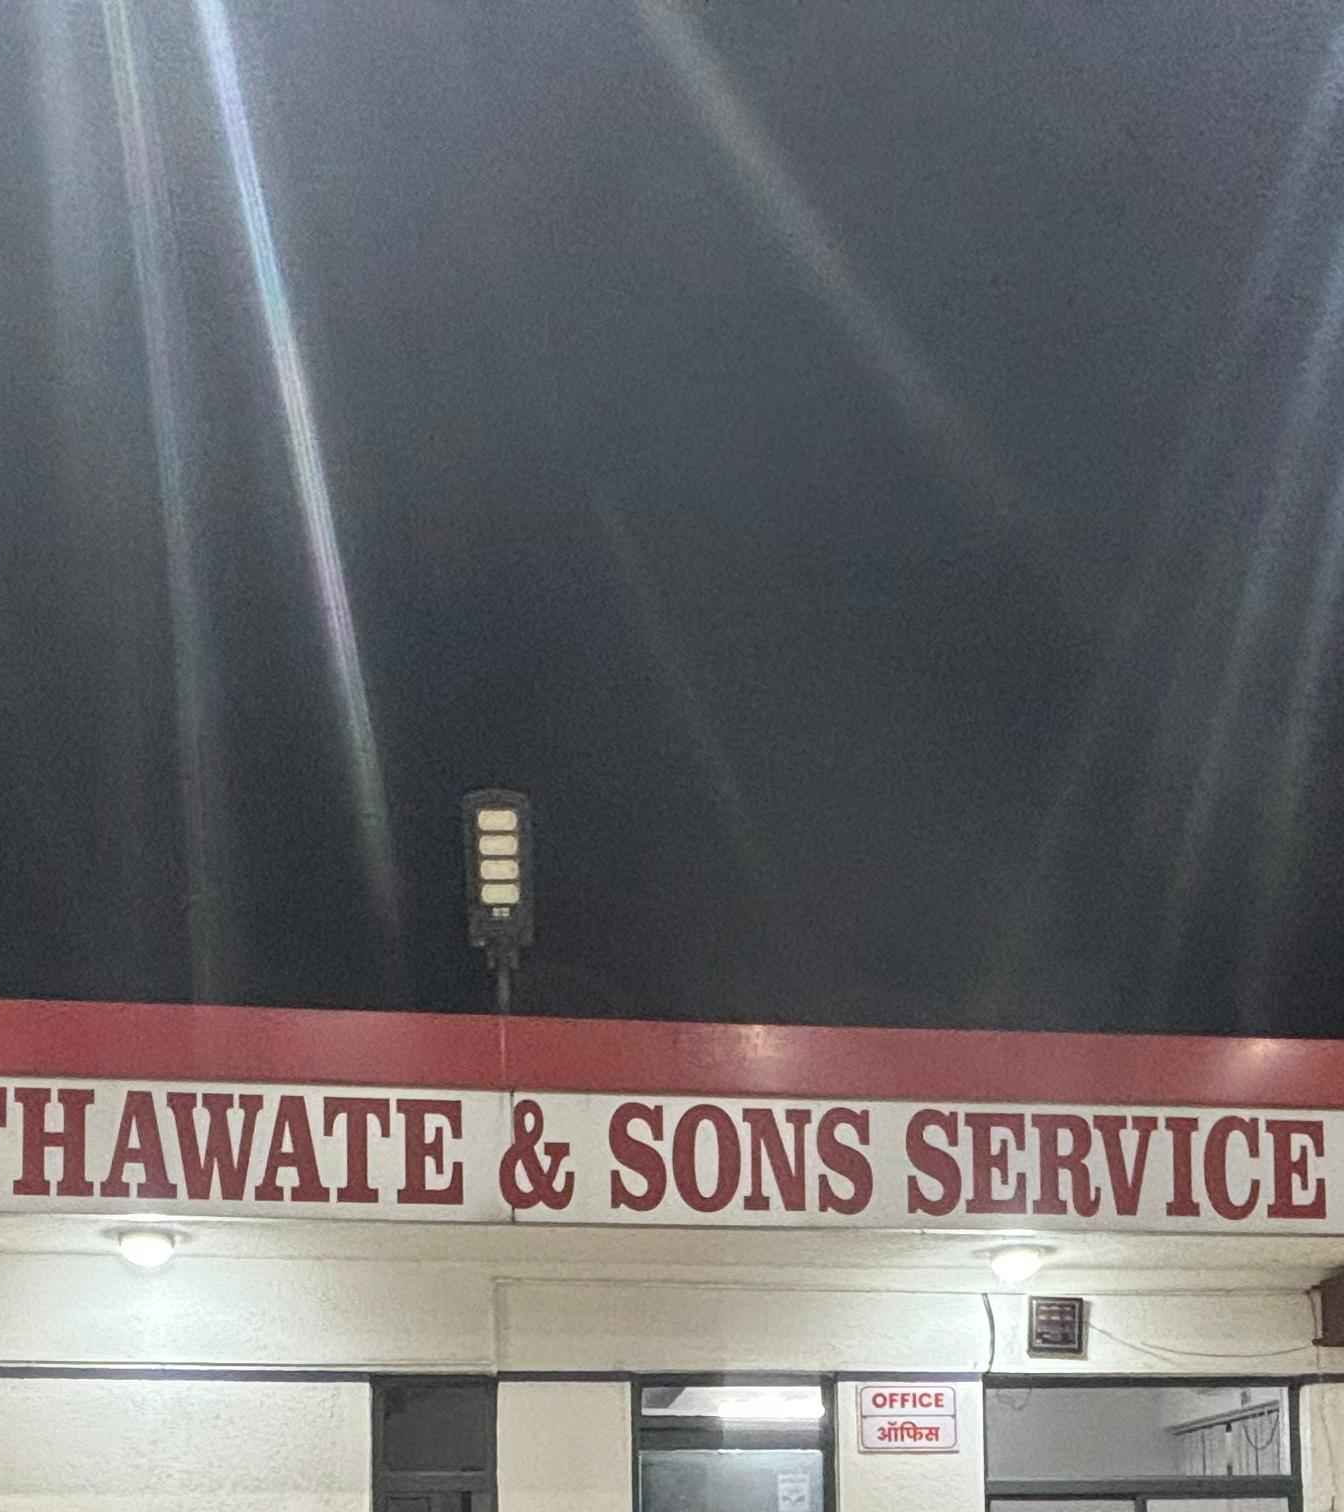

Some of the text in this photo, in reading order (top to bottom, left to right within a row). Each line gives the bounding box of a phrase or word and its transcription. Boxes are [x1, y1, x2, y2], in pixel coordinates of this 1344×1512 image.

[499, 1100, 575, 1210] &
[609, 1102, 873, 1215] SONS
[906, 1108, 1327, 1221] SERVICE
[872, 1393, 944, 1408] OFFICE
[877, 1421, 940, 1442] ऑफिस
